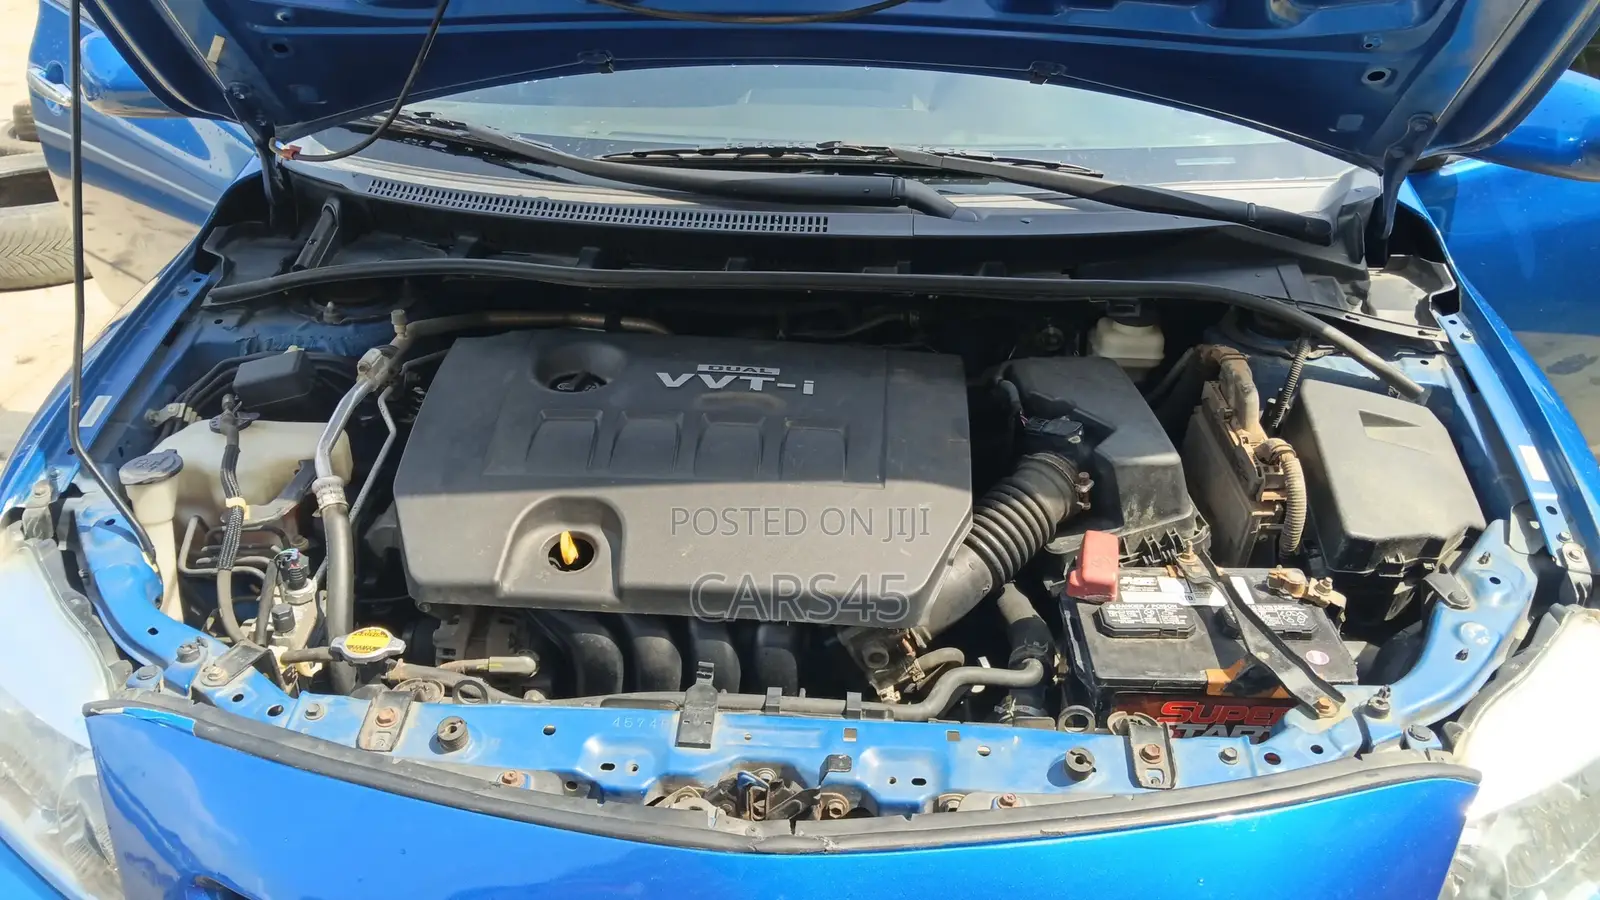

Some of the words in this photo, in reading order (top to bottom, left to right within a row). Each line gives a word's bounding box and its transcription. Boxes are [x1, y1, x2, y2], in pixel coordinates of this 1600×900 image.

[708, 365, 773, 374] DUAL
[656, 372, 814, 395] VVT-i
[1169, 724, 1272, 744] TAR
